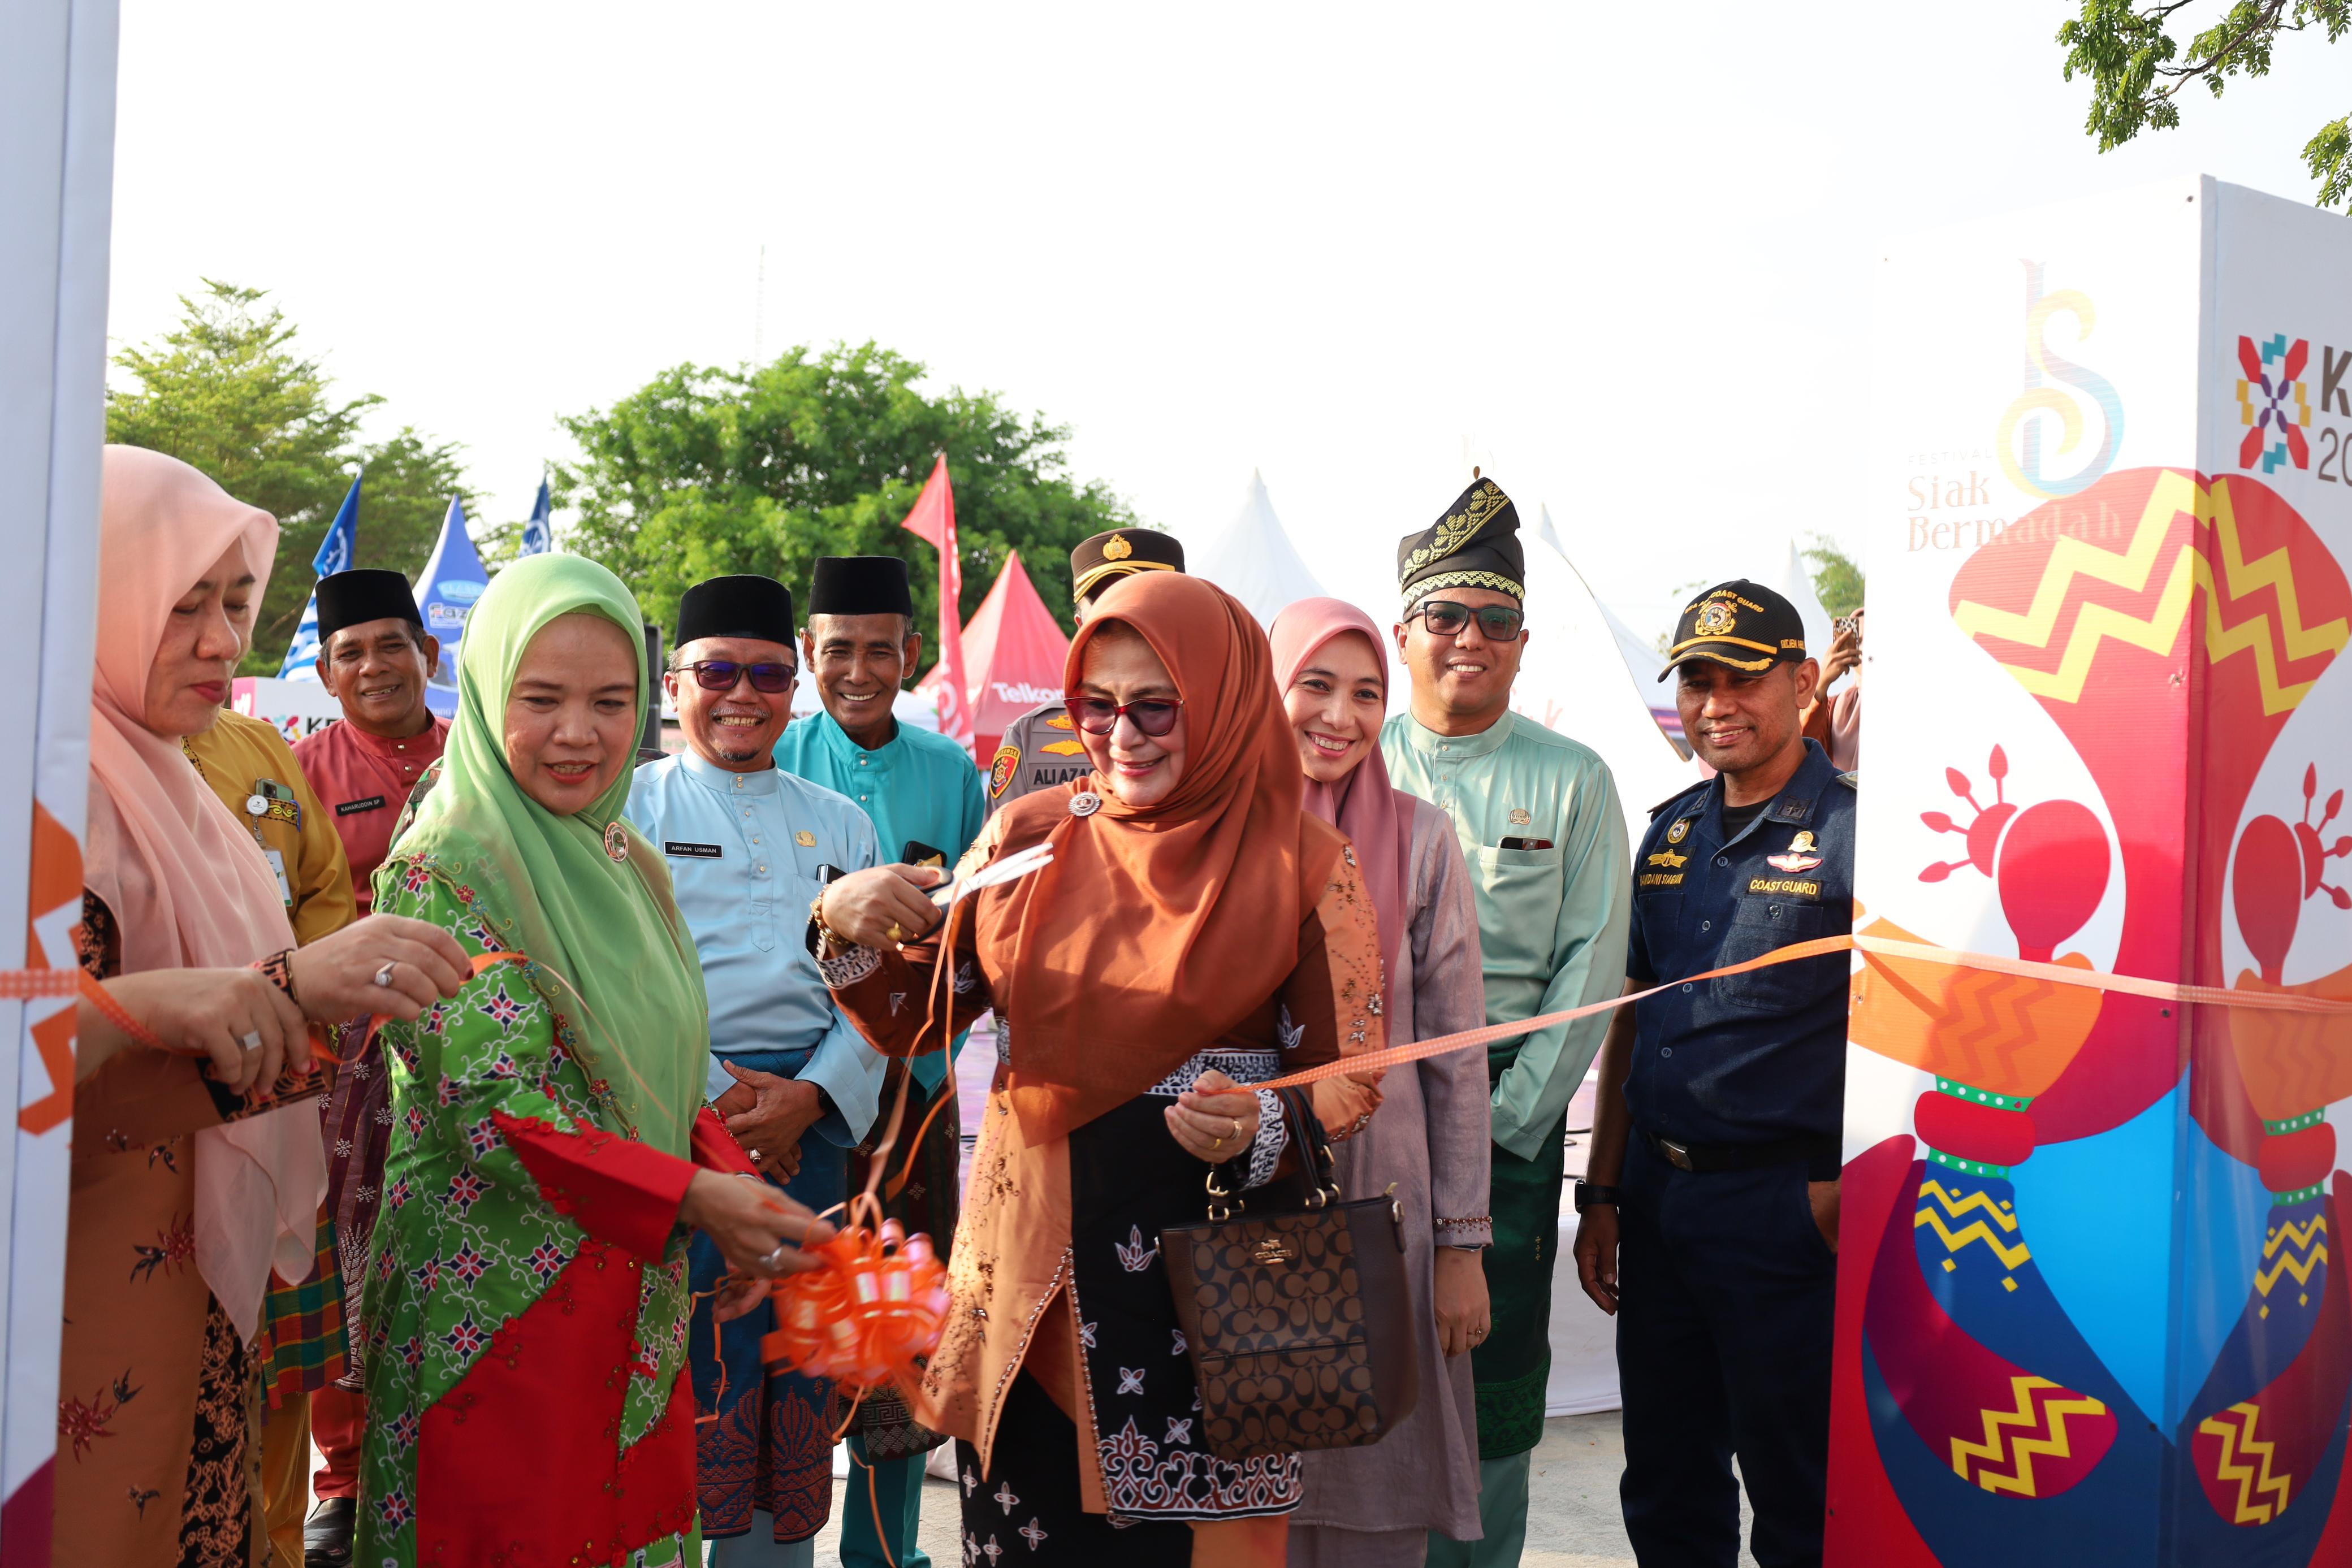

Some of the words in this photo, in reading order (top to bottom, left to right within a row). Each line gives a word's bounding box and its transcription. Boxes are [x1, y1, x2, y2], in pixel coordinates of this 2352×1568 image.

[1907, 447, 1994, 466] FESTIVAL
[1907, 470, 1991, 511] Siak
[1907, 501, 2121, 552] Bermadah
[1710, 589, 1738, 599] COAST
[1737, 597, 1765, 613] GUARD
[1033, 768, 1056, 785] ALI
[340, 800, 373, 812] KAHARUDDIN
[1750, 879, 1783, 891] COAST
[1782, 881, 1818, 895] GUARD
